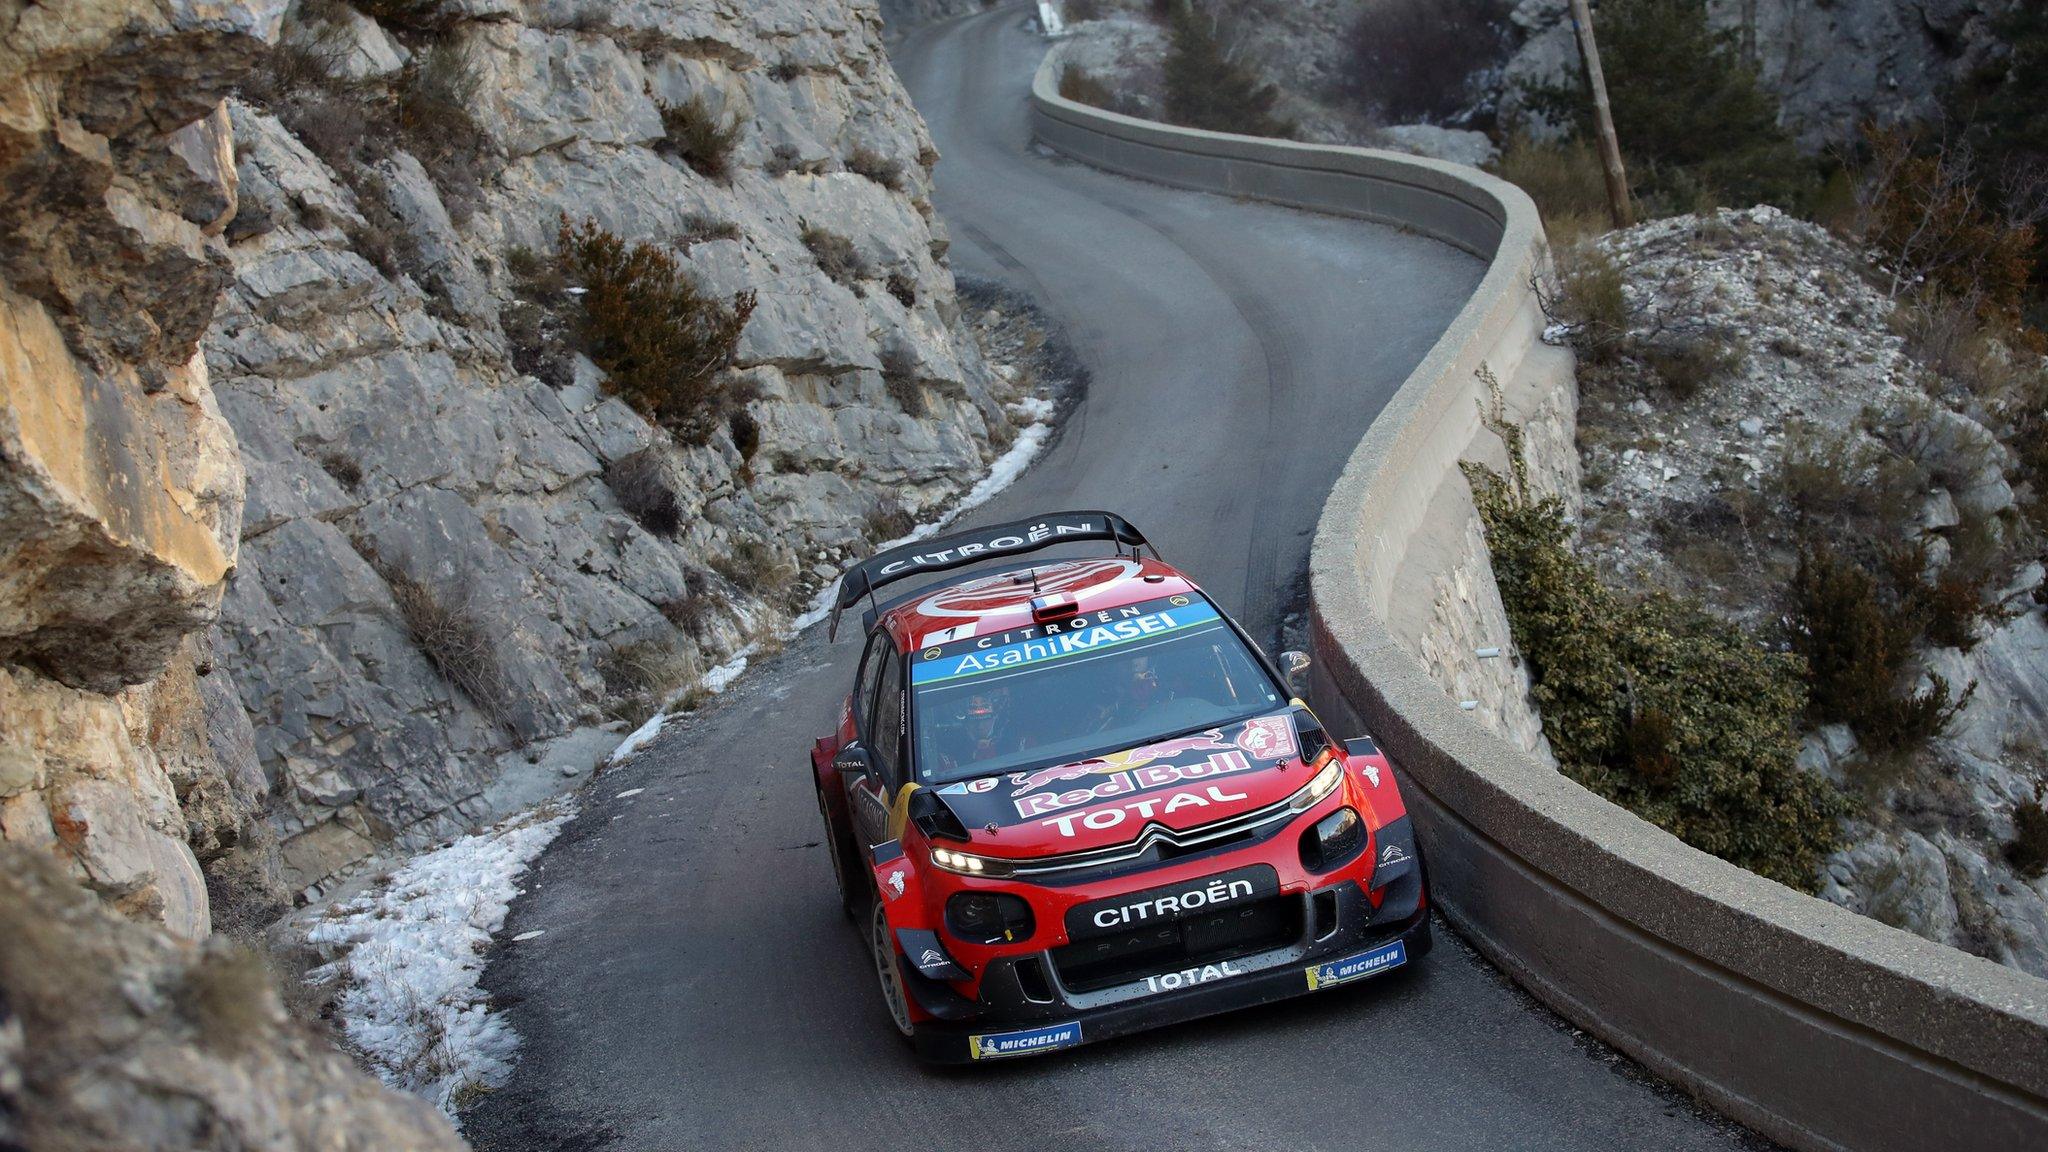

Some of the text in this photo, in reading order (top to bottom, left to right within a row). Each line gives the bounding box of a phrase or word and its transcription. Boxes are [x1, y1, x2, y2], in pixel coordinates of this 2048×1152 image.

[880, 523, 1091, 576] CITROËN
[944, 627, 957, 641] 1
[954, 612, 1179, 675] AsahiKASEI
[977, 607, 1141, 648] CITROËN
[836, 760, 865, 770] TOTAL
[1014, 750, 1251, 819] Red Bull
[1042, 786, 1247, 837] TOTAL
[1093, 879, 1254, 928] CITROËN
[1140, 961, 1242, 993] TOTAL
[1339, 950, 1398, 976] MICHELIN
[1000, 1030, 1072, 1050] MICHELIN
